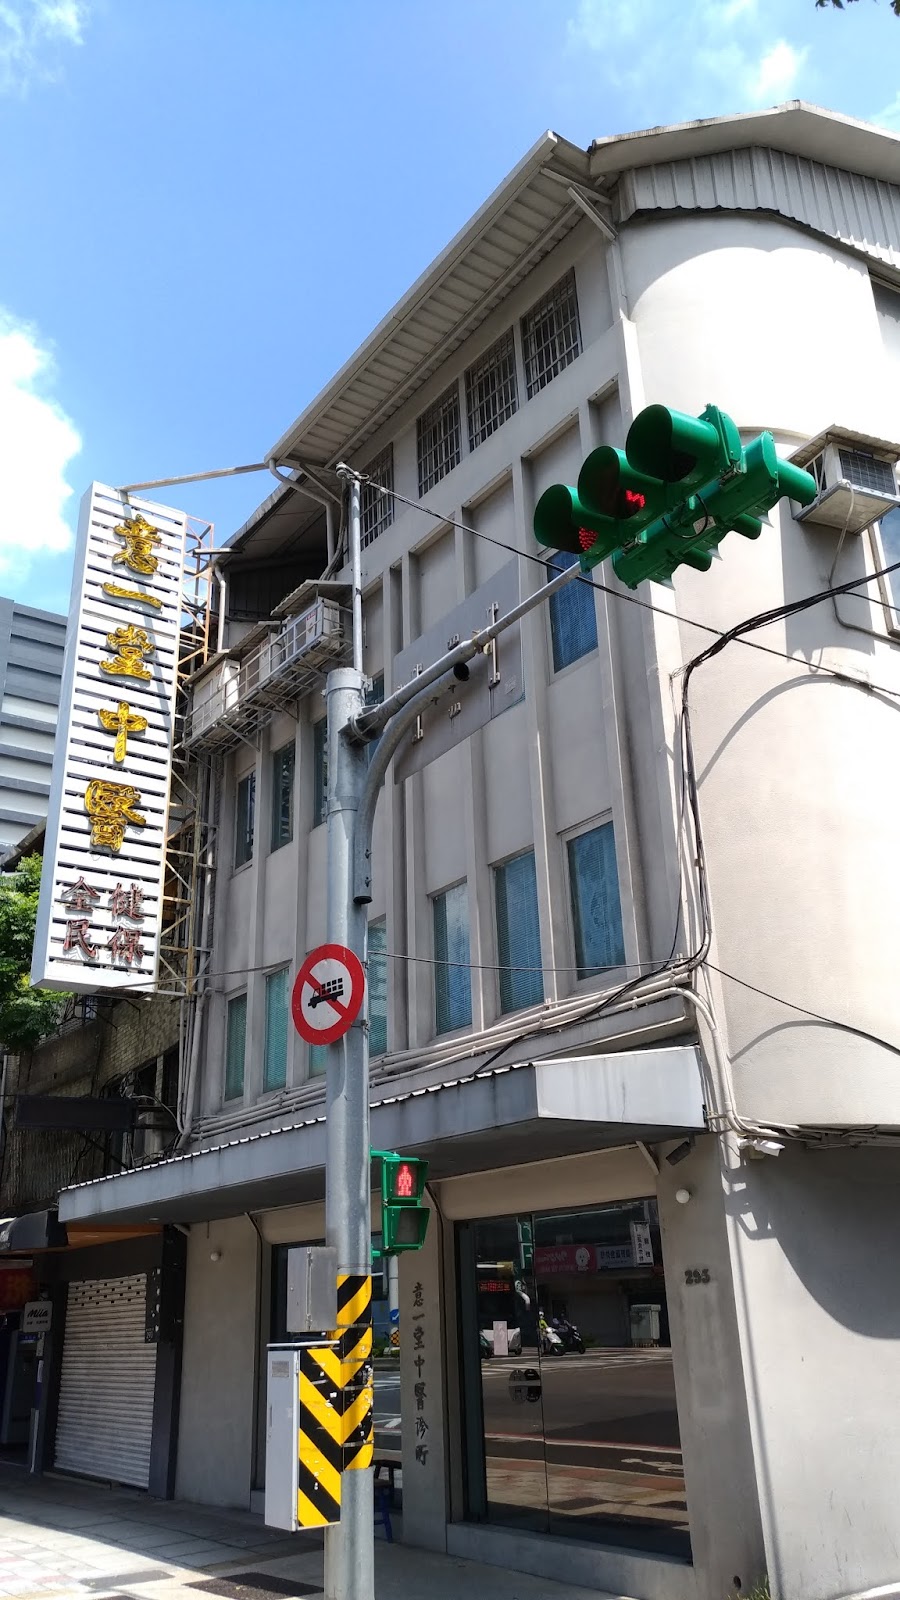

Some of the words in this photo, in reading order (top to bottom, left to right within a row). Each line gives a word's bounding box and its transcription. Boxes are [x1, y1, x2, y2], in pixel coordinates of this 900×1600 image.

[411, 1281, 430, 1467] 意一堂中醫診所
